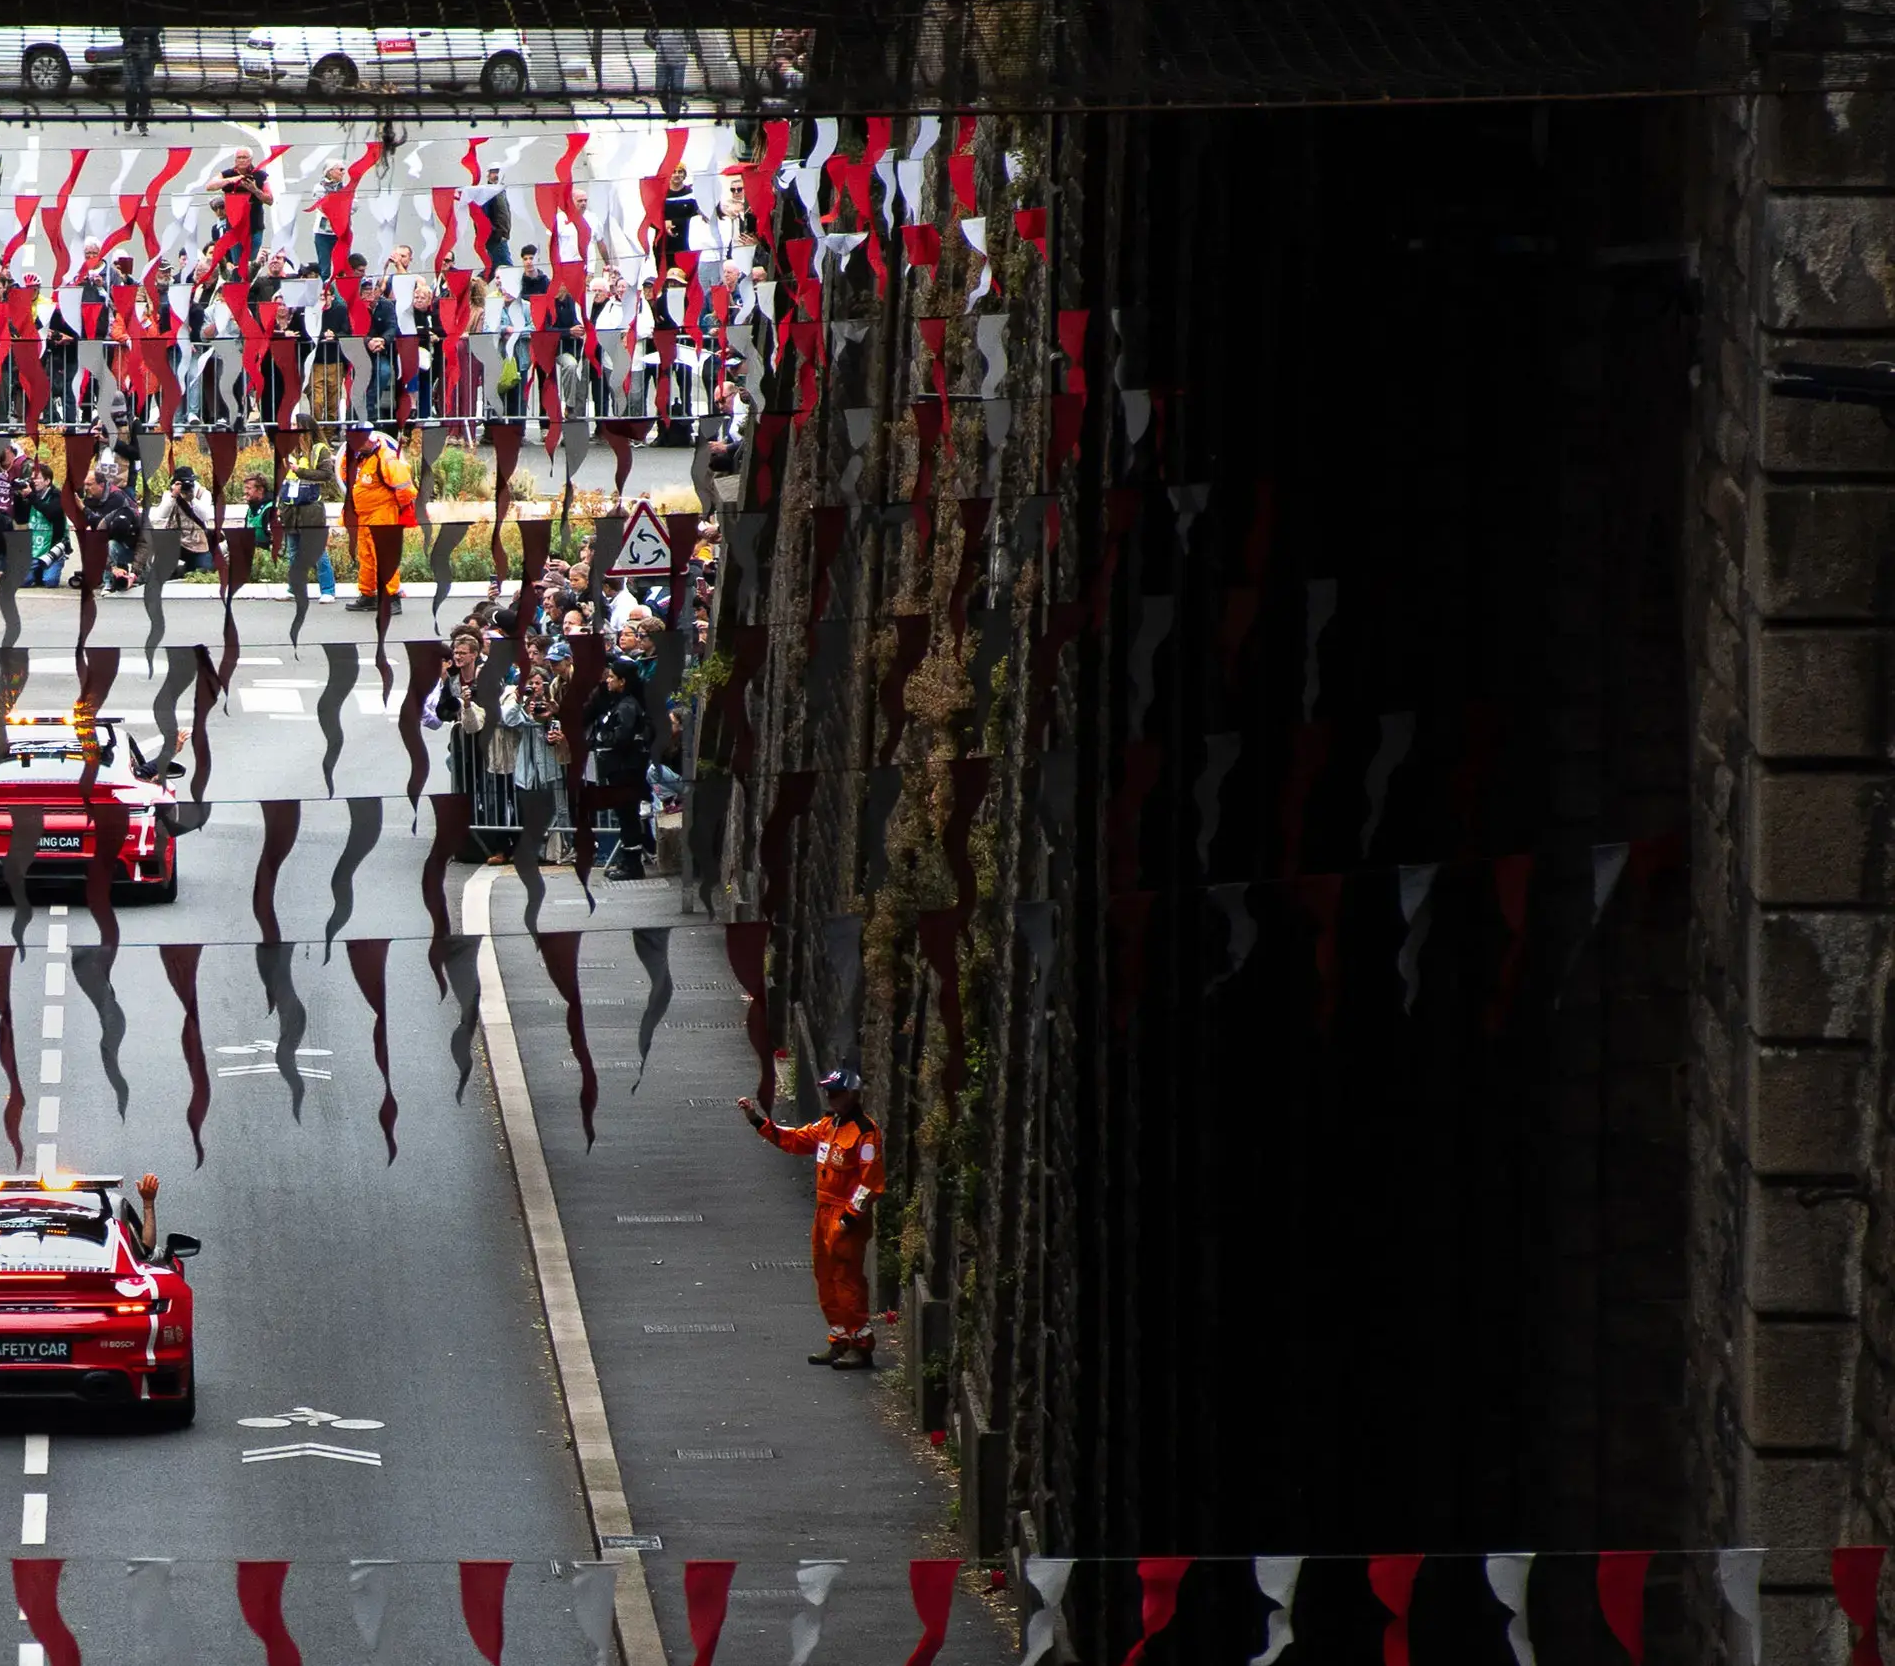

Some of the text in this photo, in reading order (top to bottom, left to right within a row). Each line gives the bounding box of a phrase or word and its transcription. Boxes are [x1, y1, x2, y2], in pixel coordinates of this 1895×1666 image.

[59, 837, 80, 847] CAR
[38, 1342, 67, 1356] CAR
[109, 1340, 135, 1349] BOSCH
